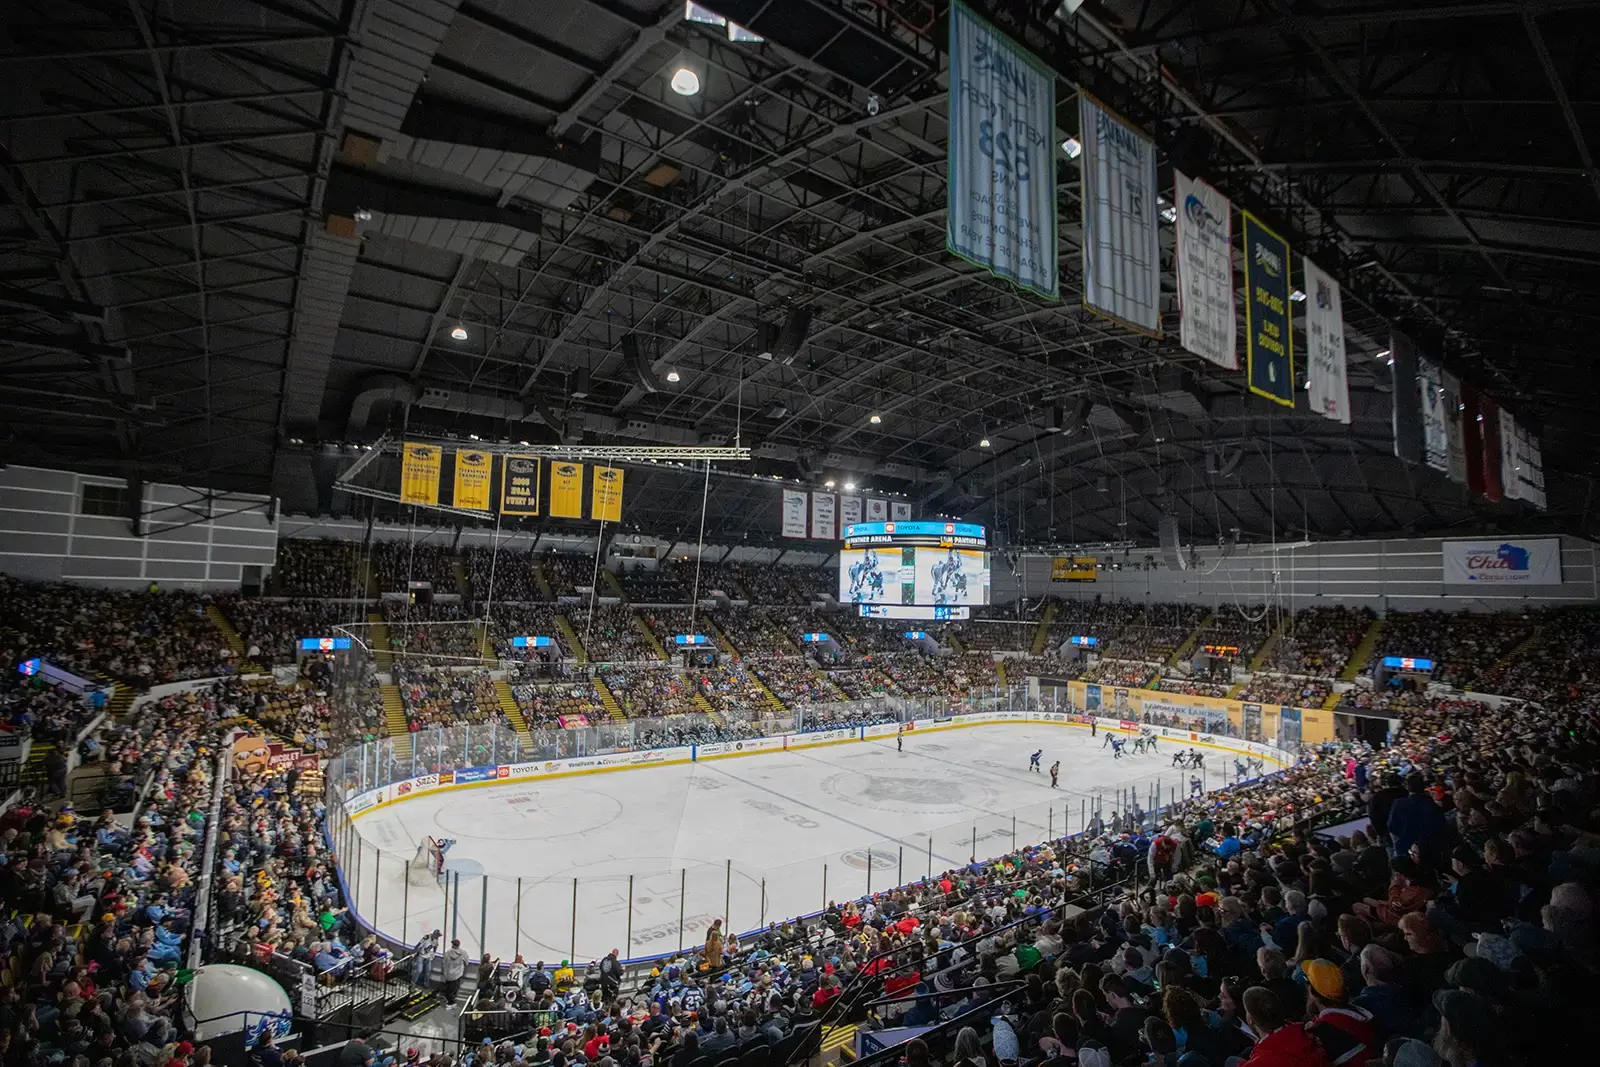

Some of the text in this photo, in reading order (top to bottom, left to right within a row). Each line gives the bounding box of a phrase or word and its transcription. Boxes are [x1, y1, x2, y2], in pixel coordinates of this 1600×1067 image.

[870, 535, 893, 543] ARENA
[954, 536, 977, 544] PANTHER
[1144, 702, 1225, 720] LANDMARK LANDING
[512, 765, 539, 775] TOYOTA
